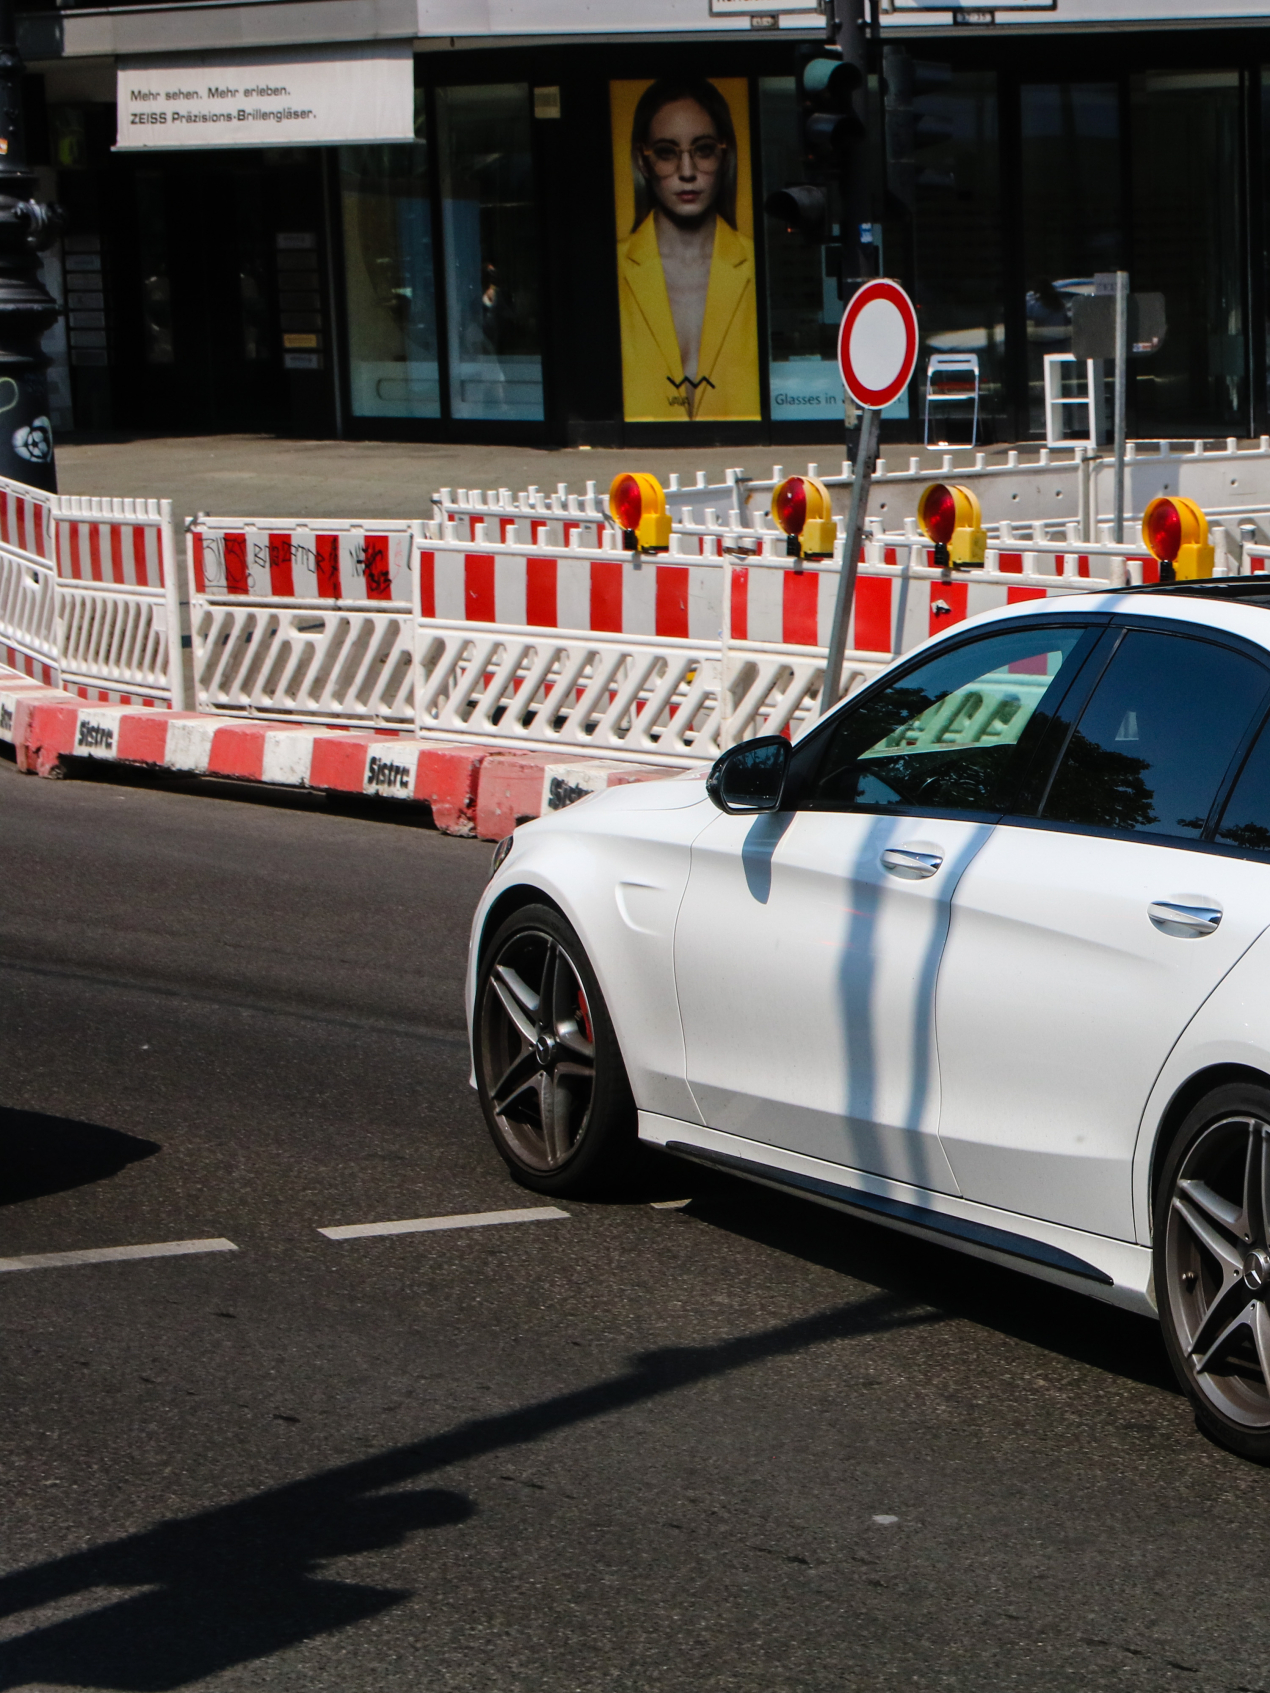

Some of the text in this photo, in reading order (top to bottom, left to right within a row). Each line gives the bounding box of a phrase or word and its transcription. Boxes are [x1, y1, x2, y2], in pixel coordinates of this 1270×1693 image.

[130, 84, 291, 101] Mehr sehen. Mehr erleben.
[130, 107, 317, 125] ZEISS Präzisions-Brillengläser.
[775, 393, 821, 406] Glasses
[826, 393, 837, 405] in
